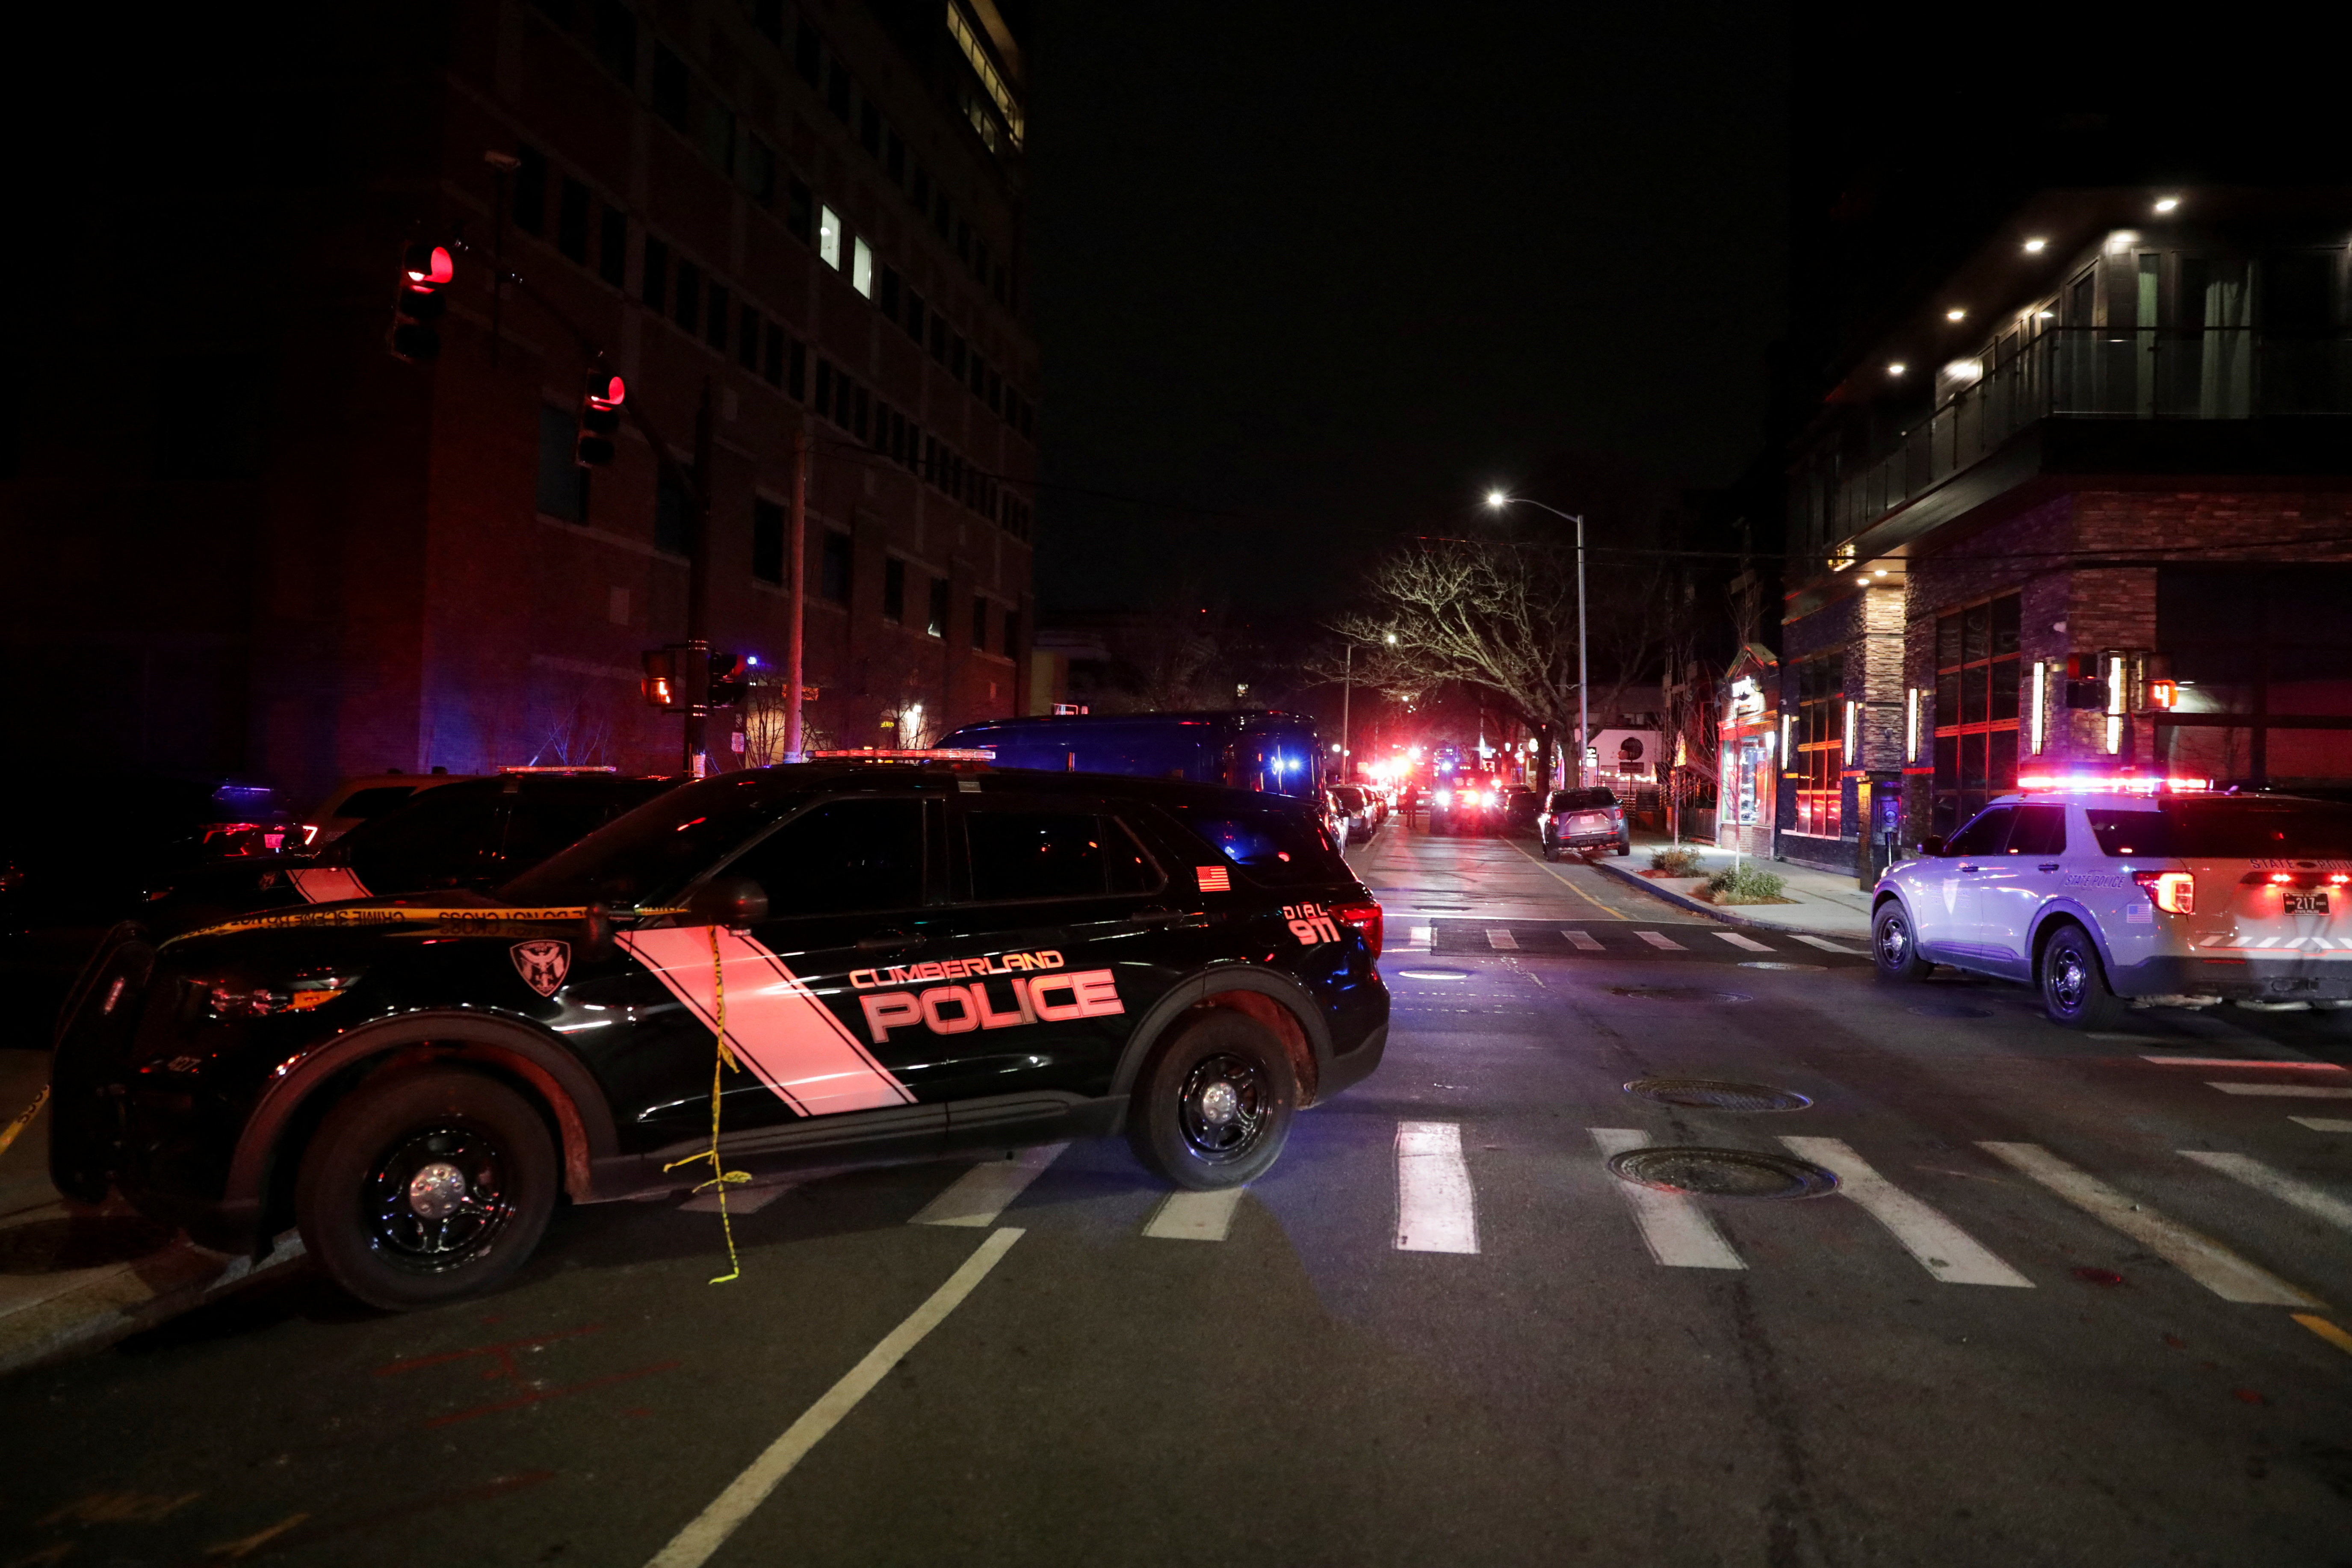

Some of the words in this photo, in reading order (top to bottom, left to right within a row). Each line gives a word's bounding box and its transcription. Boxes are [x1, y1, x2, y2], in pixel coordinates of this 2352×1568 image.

[2250, 859, 2295, 869] STATE
[2065, 875, 2091, 886] STATE
[2092, 875, 2125, 888] POLICE
[1282, 903, 1328, 919] DIAL
[2296, 897, 2315, 909] 217
[1288, 917, 1341, 945] 911
[849, 950, 1064, 989] CUMBERLAND
[859, 969, 1125, 1044] POLICE
